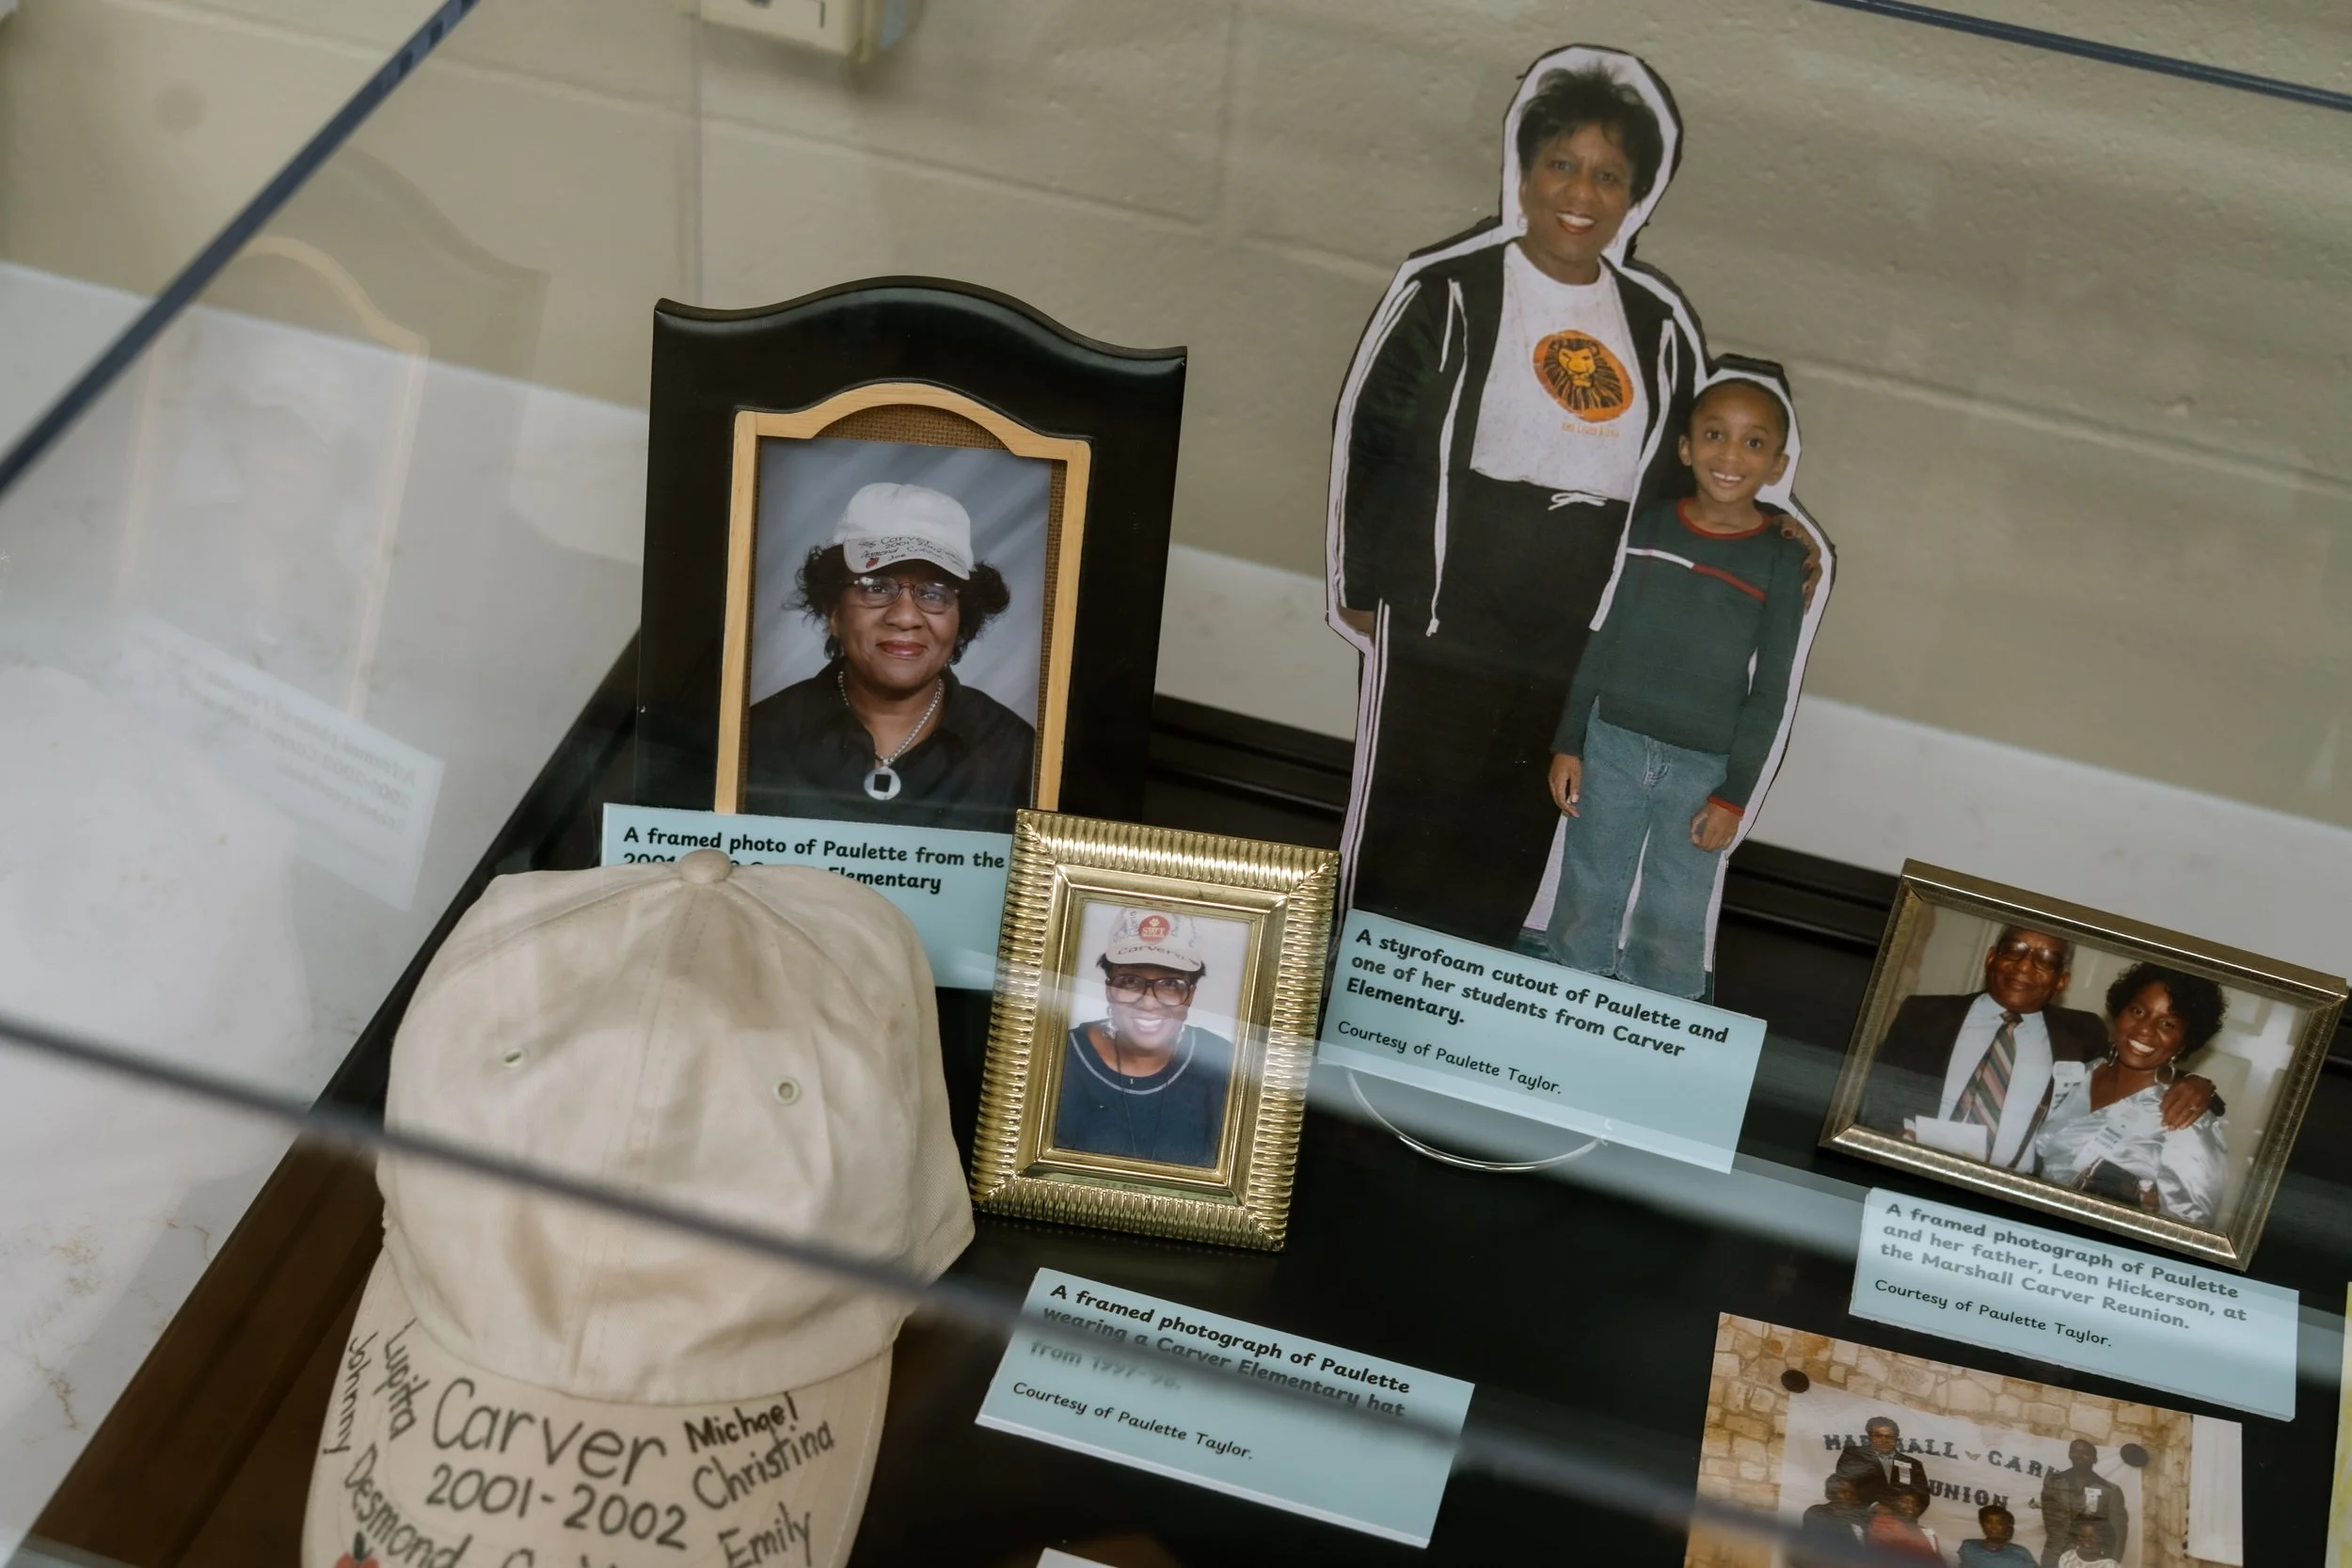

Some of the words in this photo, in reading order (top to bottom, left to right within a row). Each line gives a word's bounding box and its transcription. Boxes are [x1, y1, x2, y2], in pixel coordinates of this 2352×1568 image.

[623, 826, 640, 844] A
[647, 827, 723, 848] framed
[728, 834, 787, 854] photo
[794, 838, 818, 855] of
[823, 841, 908, 862] Paulette
[916, 846, 965, 866] from
[973, 851, 1006, 869] the
[1346, 976, 1465, 1025] Elementary.
[1352, 957, 1386, 974] one
[1393, 966, 1418, 982] of
[1422, 971, 1455, 993] her
[1461, 986, 1548, 1020] students
[1555, 1008, 1605, 1036] from
[1613, 1025, 1685, 1056] Carver
[1356, 928, 1372, 945] A
[1378, 938, 1485, 976] styrofoam
[1492, 969, 1559, 996] cutout
[1565, 988, 1590, 1004] of
[1595, 993, 1681, 1030] Paulette
[1688, 1022, 1729, 1043] and
[1338, 1021, 1407, 1053] Courtesy
[1413, 1043, 1432, 1056] of
[1436, 1048, 1501, 1076] Paulette
[1507, 1067, 1562, 1095] Taylor.
[1881, 1243, 1914, 1261] the
[1921, 1252, 2013, 1286] Marshall
[2021, 1276, 2094, 1307] Carver
[2102, 1296, 2190, 1329] Reunion.
[1883, 1225, 1923, 1243] and
[1930, 1232, 1964, 1252] her
[1971, 1243, 2043, 1274] father,
[2051, 1262, 2099, 1286] Leon
[2107, 1276, 2215, 1316] Hickerson,
[2223, 1307, 2248, 1322] at
[1885, 1203, 1901, 1217] A
[1910, 1208, 1986, 1237] framed
[1993, 1230, 2113, 1269] photograph
[2121, 1261, 2145, 1275] of
[2151, 1266, 2239, 1298] Paulette
[1030, 1339, 1082, 1366] from
[1049, 1285, 1068, 1300] A
[1075, 1291, 1155, 1323] framed
[1157, 1317, 1282, 1359] photograph
[1290, 1353, 1316, 1367] of
[1319, 1357, 1410, 1394] Paulette
[1875, 1279, 1947, 1309] Courtesy
[1955, 1299, 1974, 1312] of
[1979, 1304, 2046, 1331] Paulette
[2055, 1323, 2111, 1347] Taylor.
[1042, 1307, 1127, 1343] wearing
[1134, 1332, 1149, 1347] a
[1156, 1337, 1232, 1368] Carver
[1237, 1359, 1360, 1408] Elementary
[1366, 1393, 1406, 1417] hat
[433, 1378, 667, 1485] Carver
[683, 1390, 799, 1454] Michael
[1012, 1382, 1088, 1415] Courtesy
[1094, 1406, 1115, 1418] of
[1118, 1412, 1187, 1440] Paulette
[1196, 1432, 1253, 1459] Taylor.
[344, 1441, 472, 1568] Desmond
[425, 1464, 689, 1550] 2001-2002
[692, 1421, 835, 1510] Christina
[718, 1501, 811, 1568] Emily
